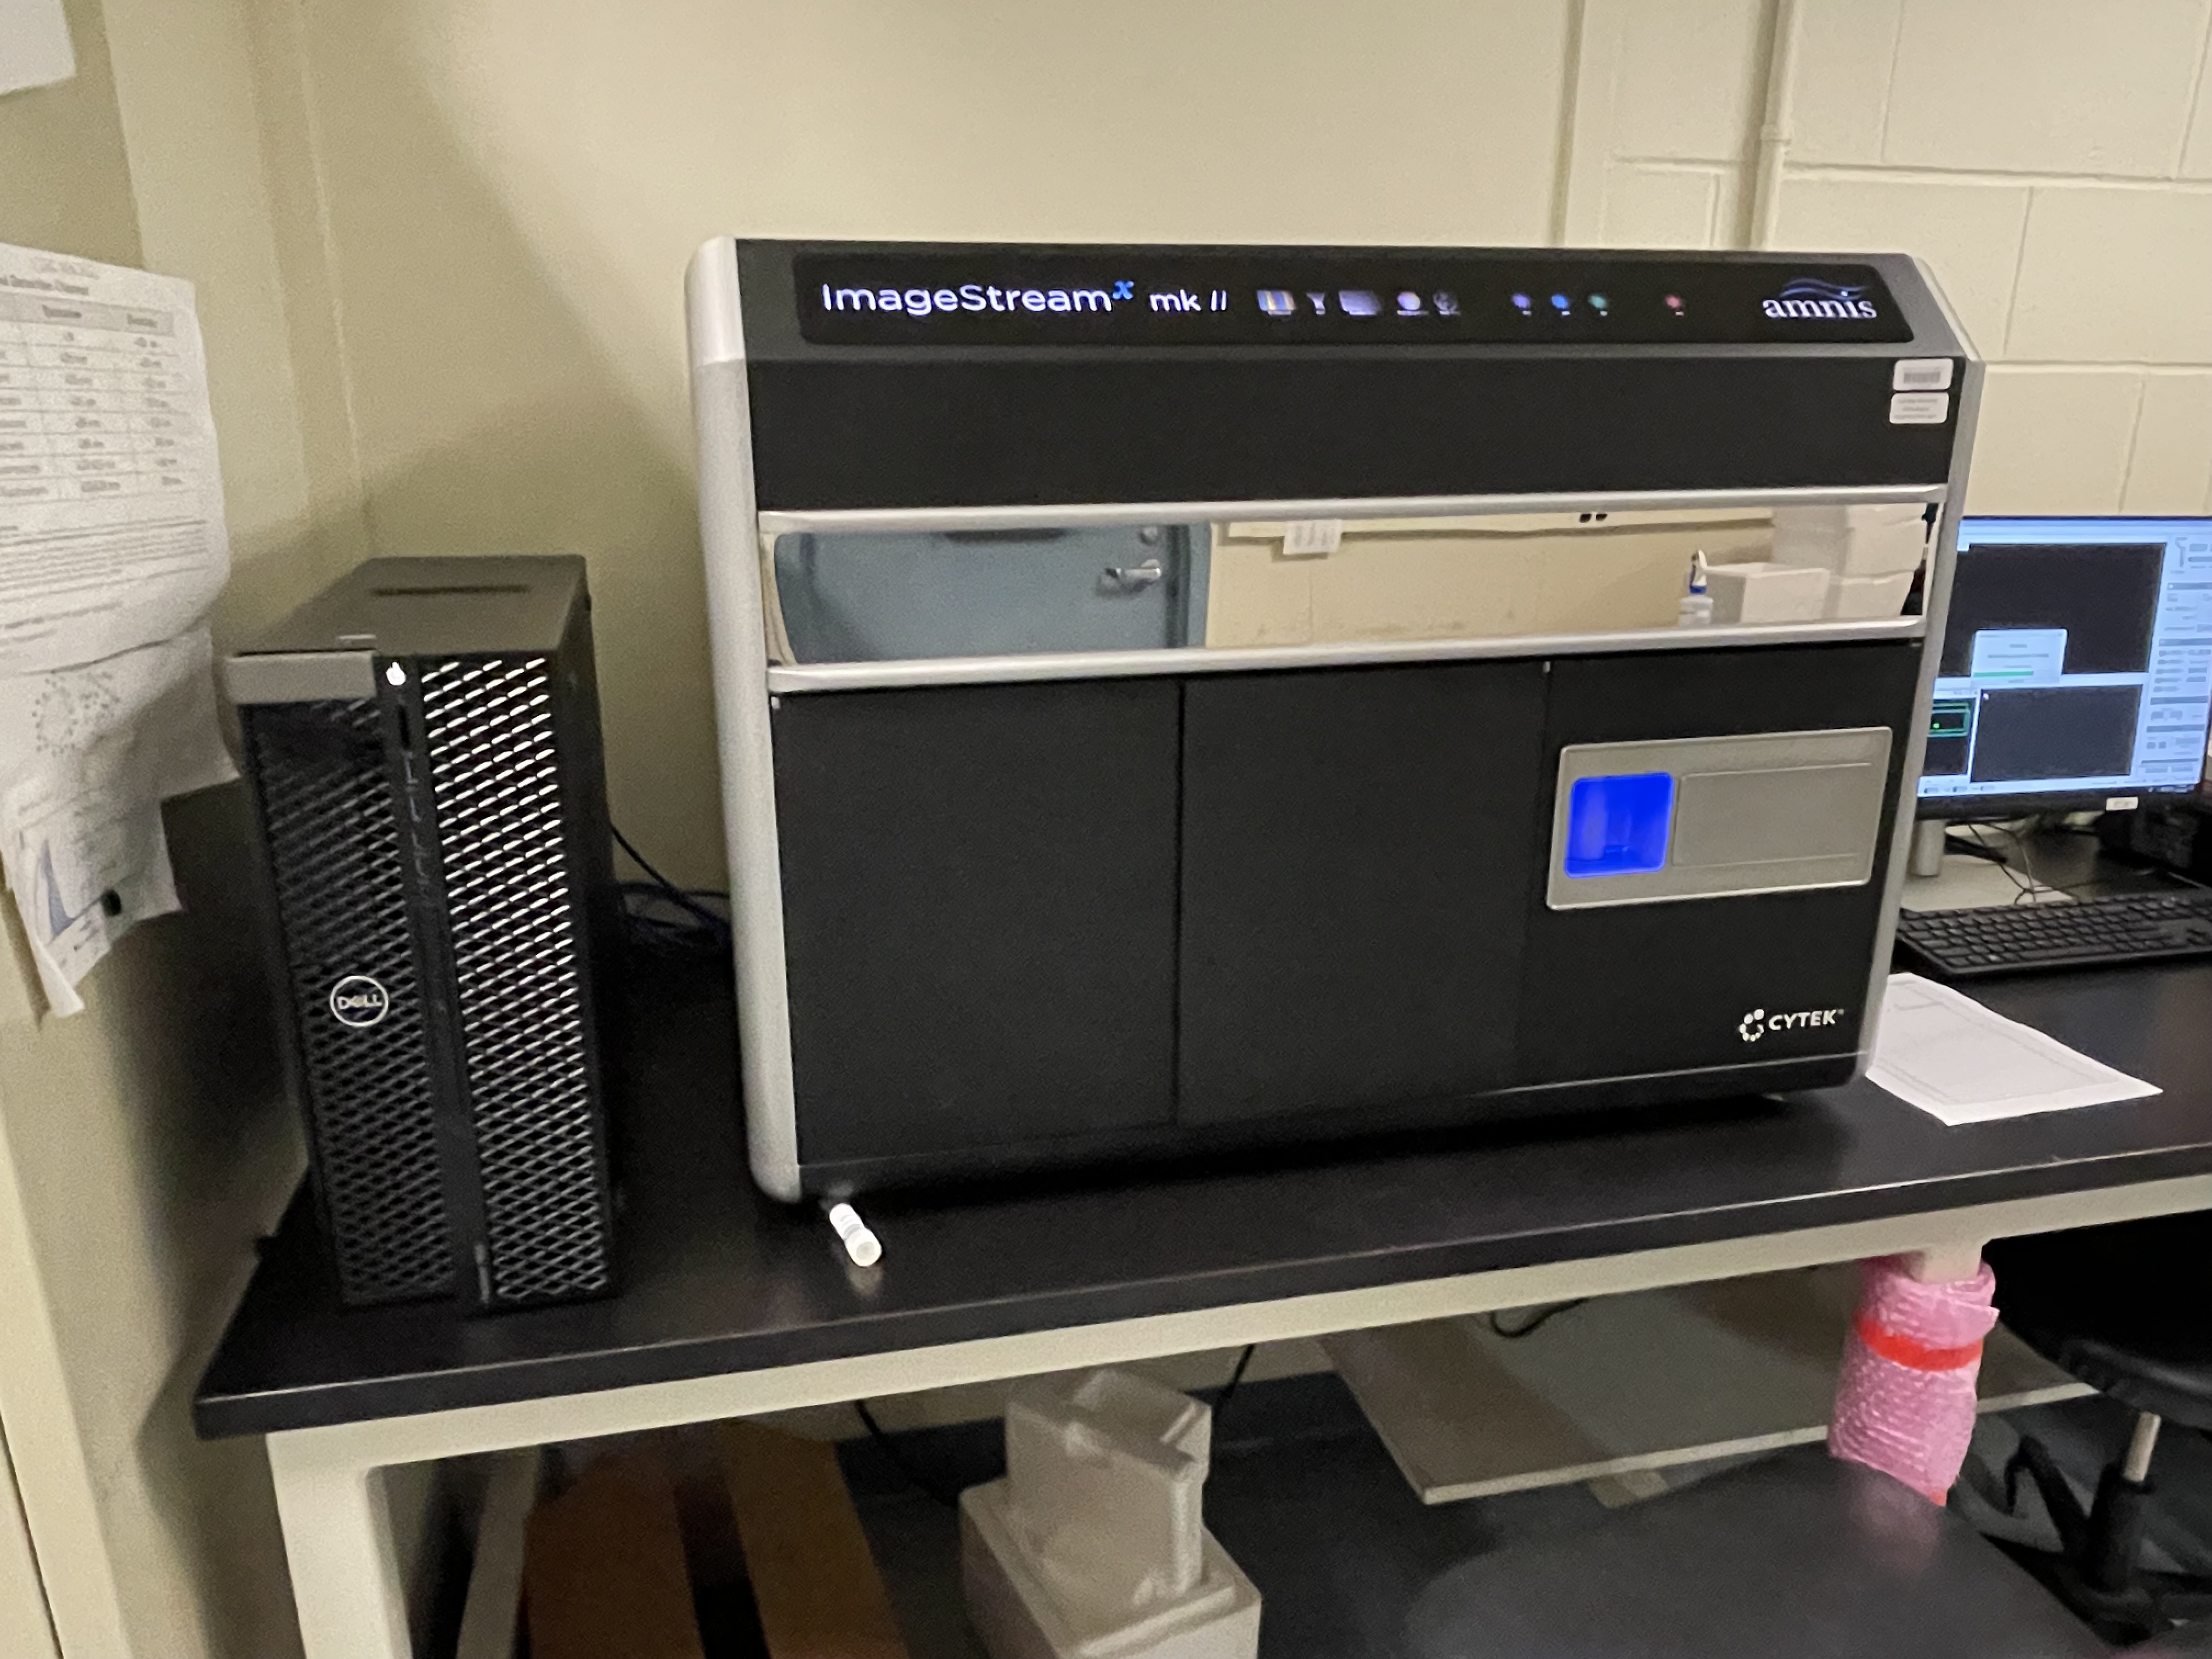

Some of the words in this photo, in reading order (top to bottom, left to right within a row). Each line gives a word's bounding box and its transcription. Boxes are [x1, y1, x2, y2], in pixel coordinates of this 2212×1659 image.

[1149, 289, 1201, 312] mk
[1762, 291, 1877, 318] amnis
[1769, 1009, 1836, 1030] CYTEK
